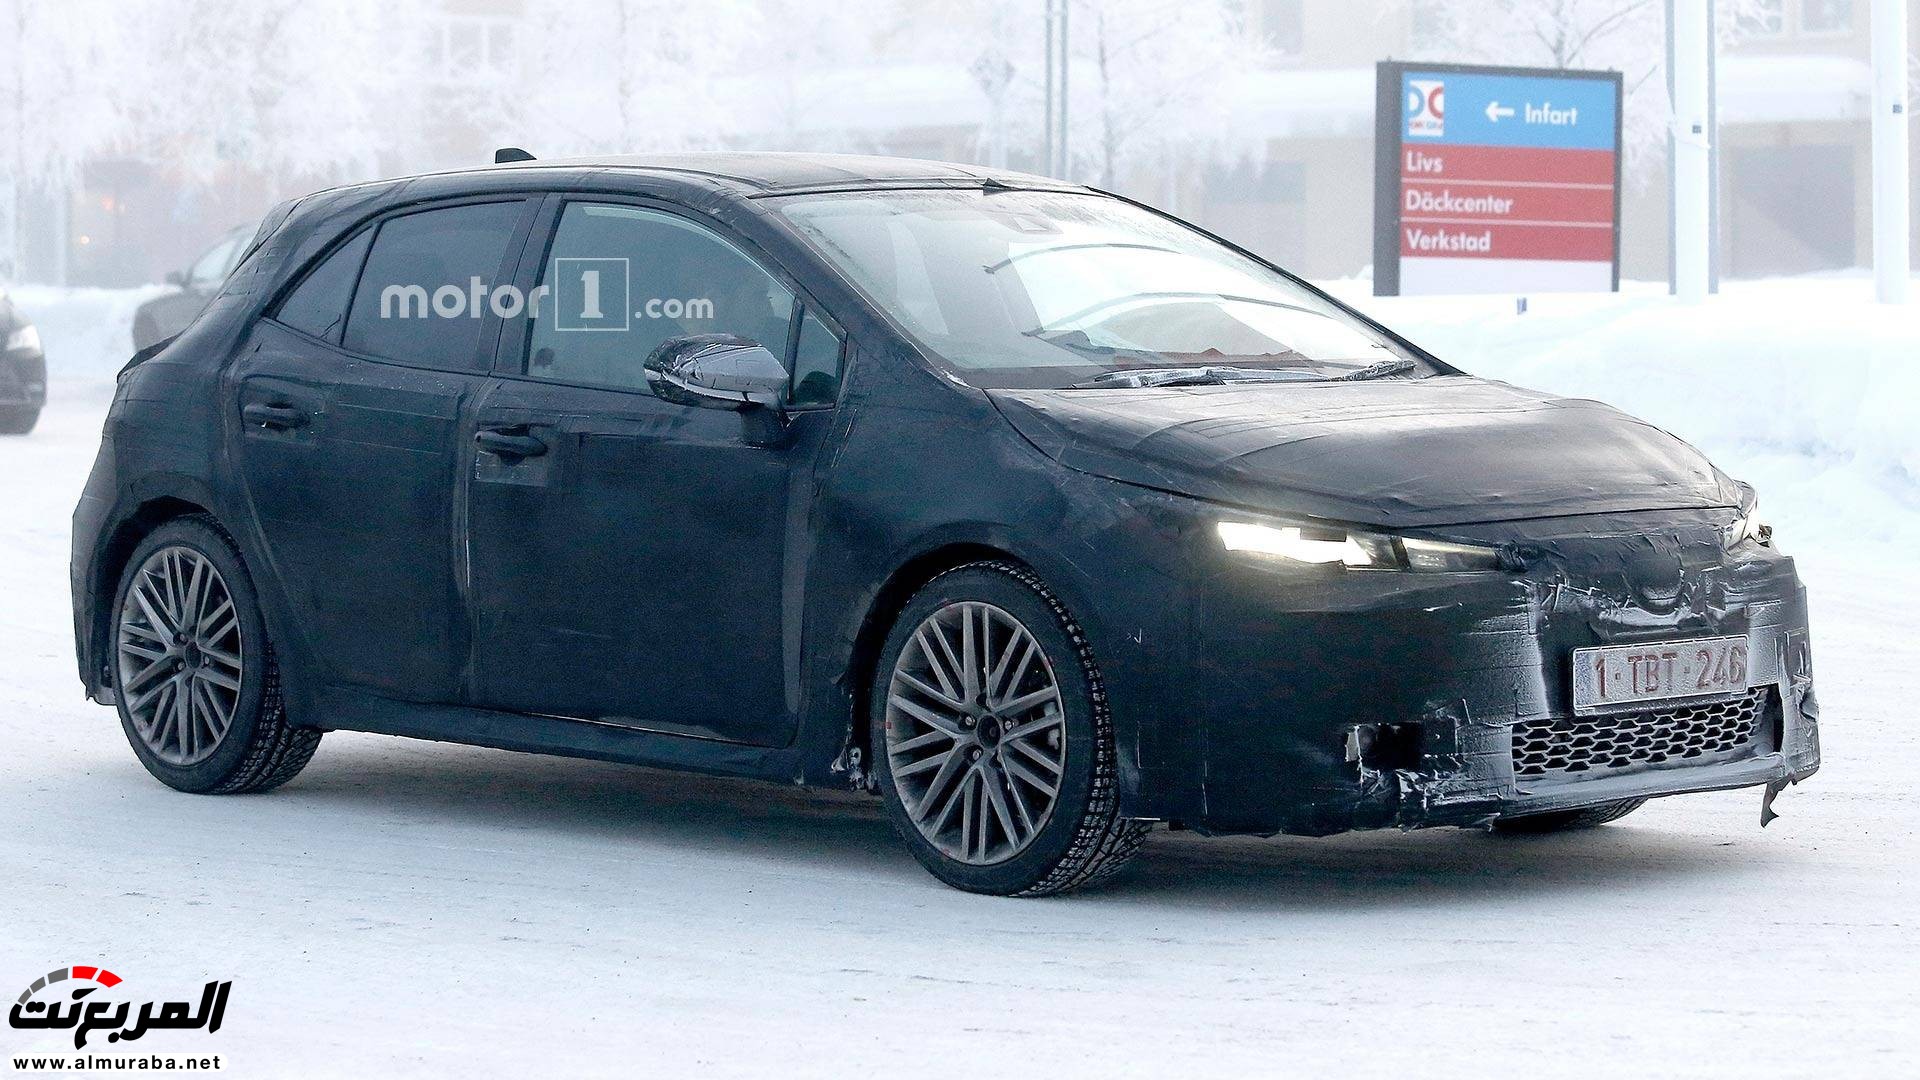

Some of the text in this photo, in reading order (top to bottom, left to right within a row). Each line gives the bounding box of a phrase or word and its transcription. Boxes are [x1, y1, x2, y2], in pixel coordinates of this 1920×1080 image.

[1525, 103, 1578, 126] Infart
[1406, 151, 1443, 172] Livs
[1405, 190, 1513, 214] Däckcenter
[1406, 229, 1491, 251] Verkstad
